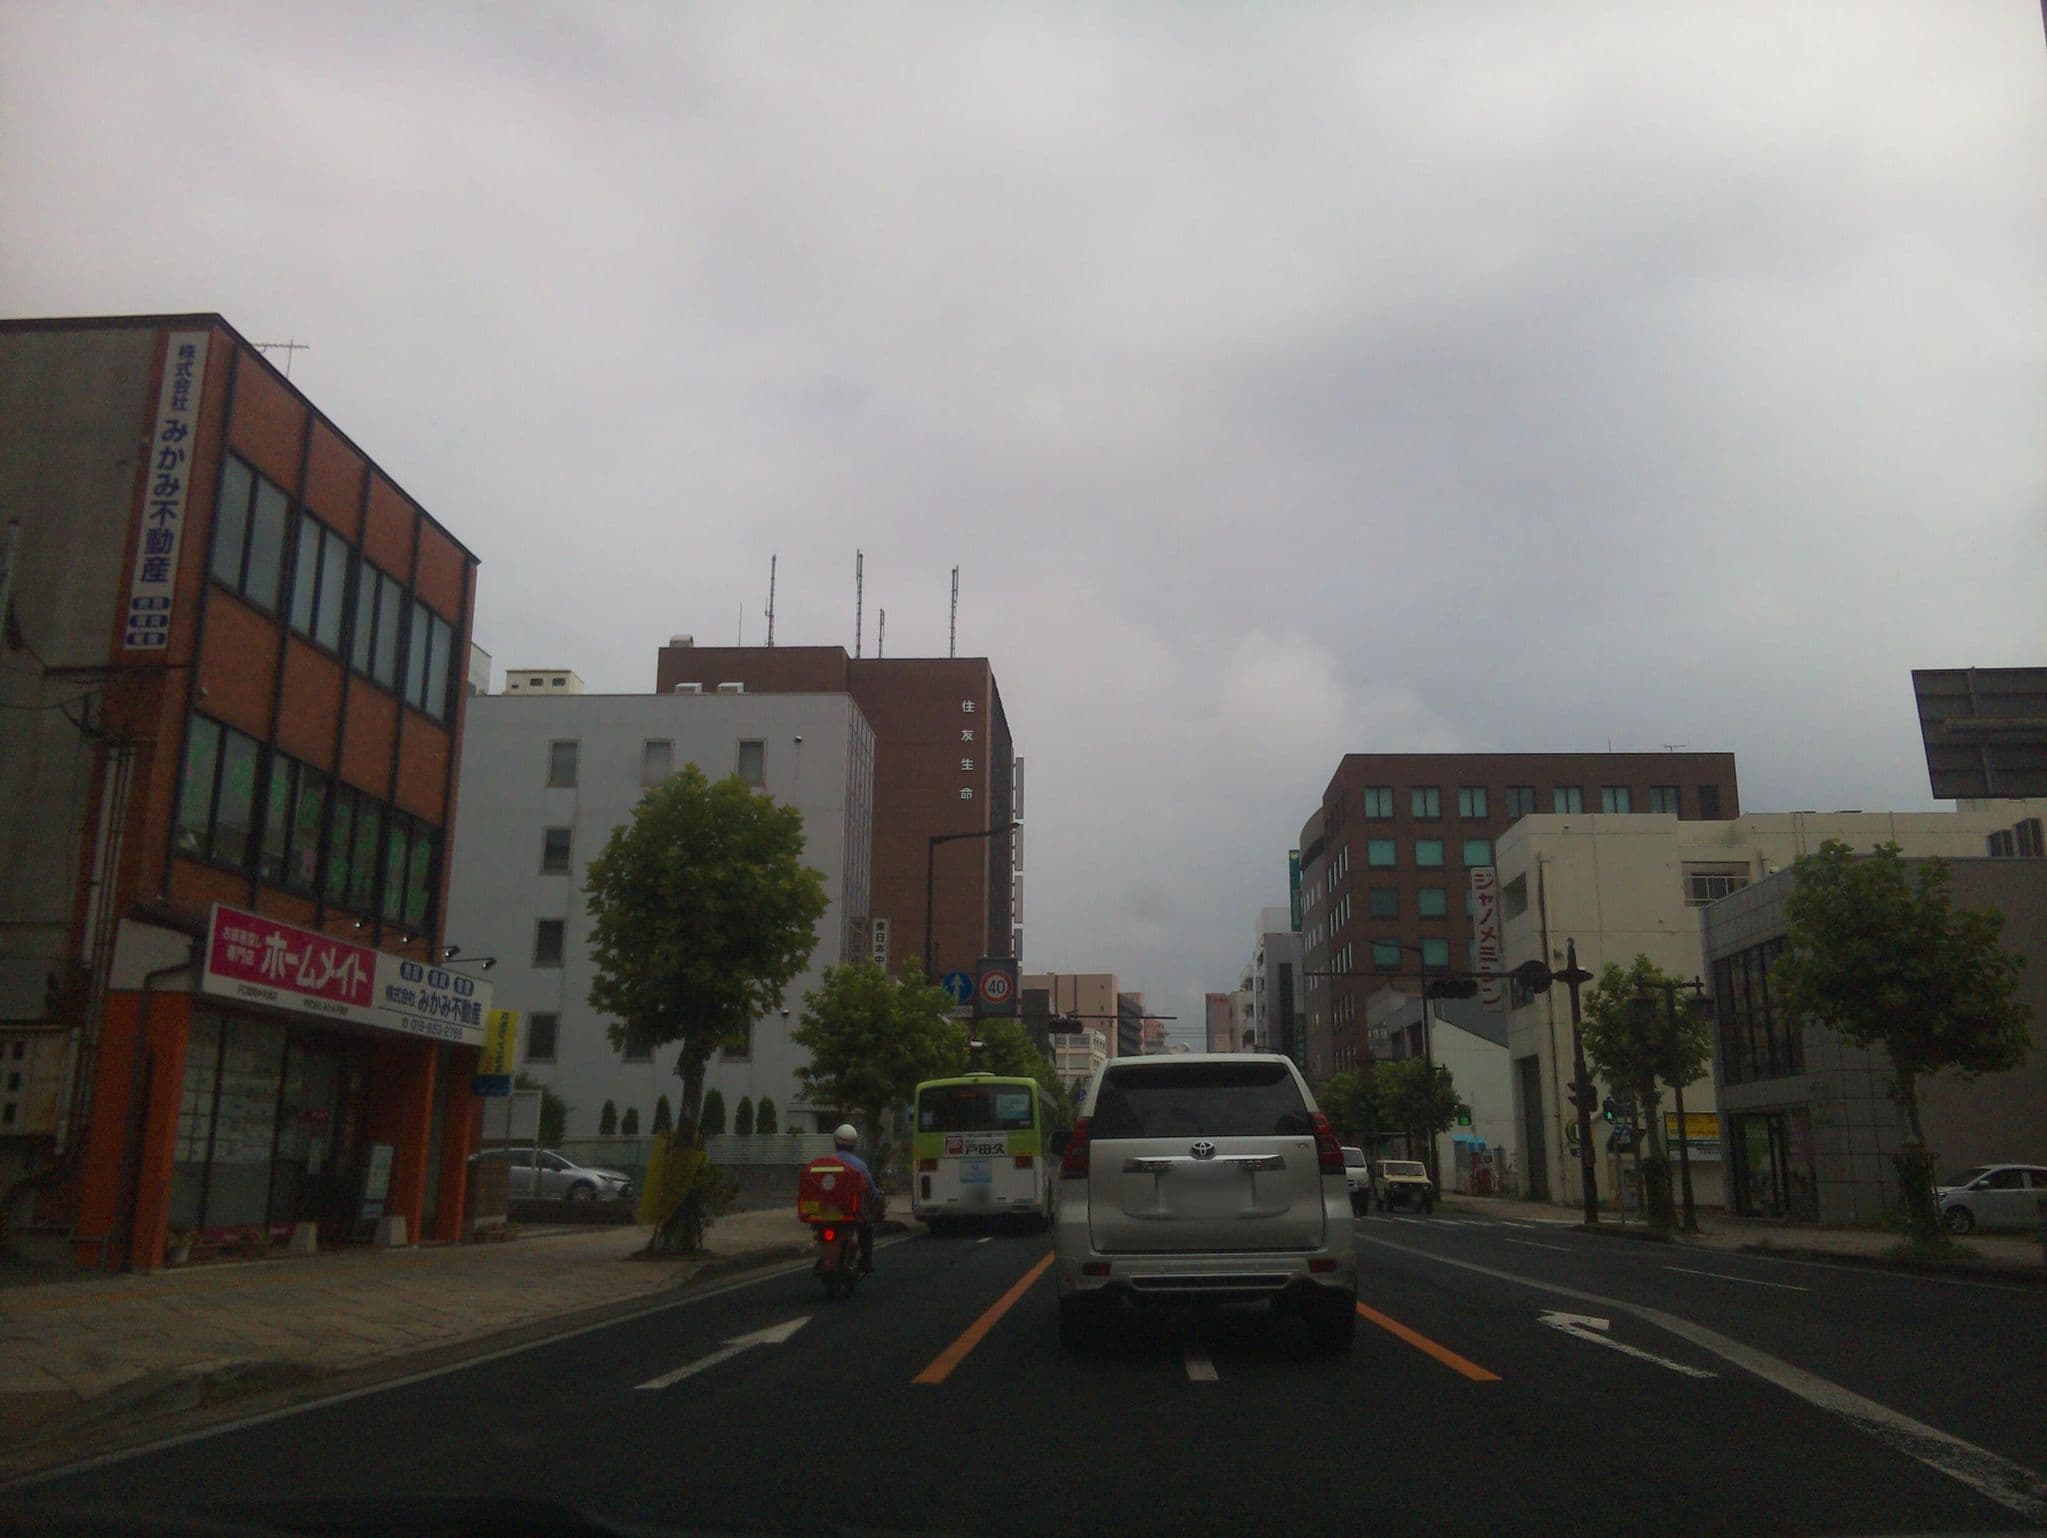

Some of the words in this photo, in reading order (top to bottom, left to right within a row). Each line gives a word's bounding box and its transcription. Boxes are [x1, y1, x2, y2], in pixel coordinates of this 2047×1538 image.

[140, 418, 189, 583] みかみ不動産
[960, 699, 975, 800] 住友生命
[260, 930, 369, 999] ホームメイト
[988, 980, 1005, 994] 40
[418, 989, 482, 1026] みかみ不動産
